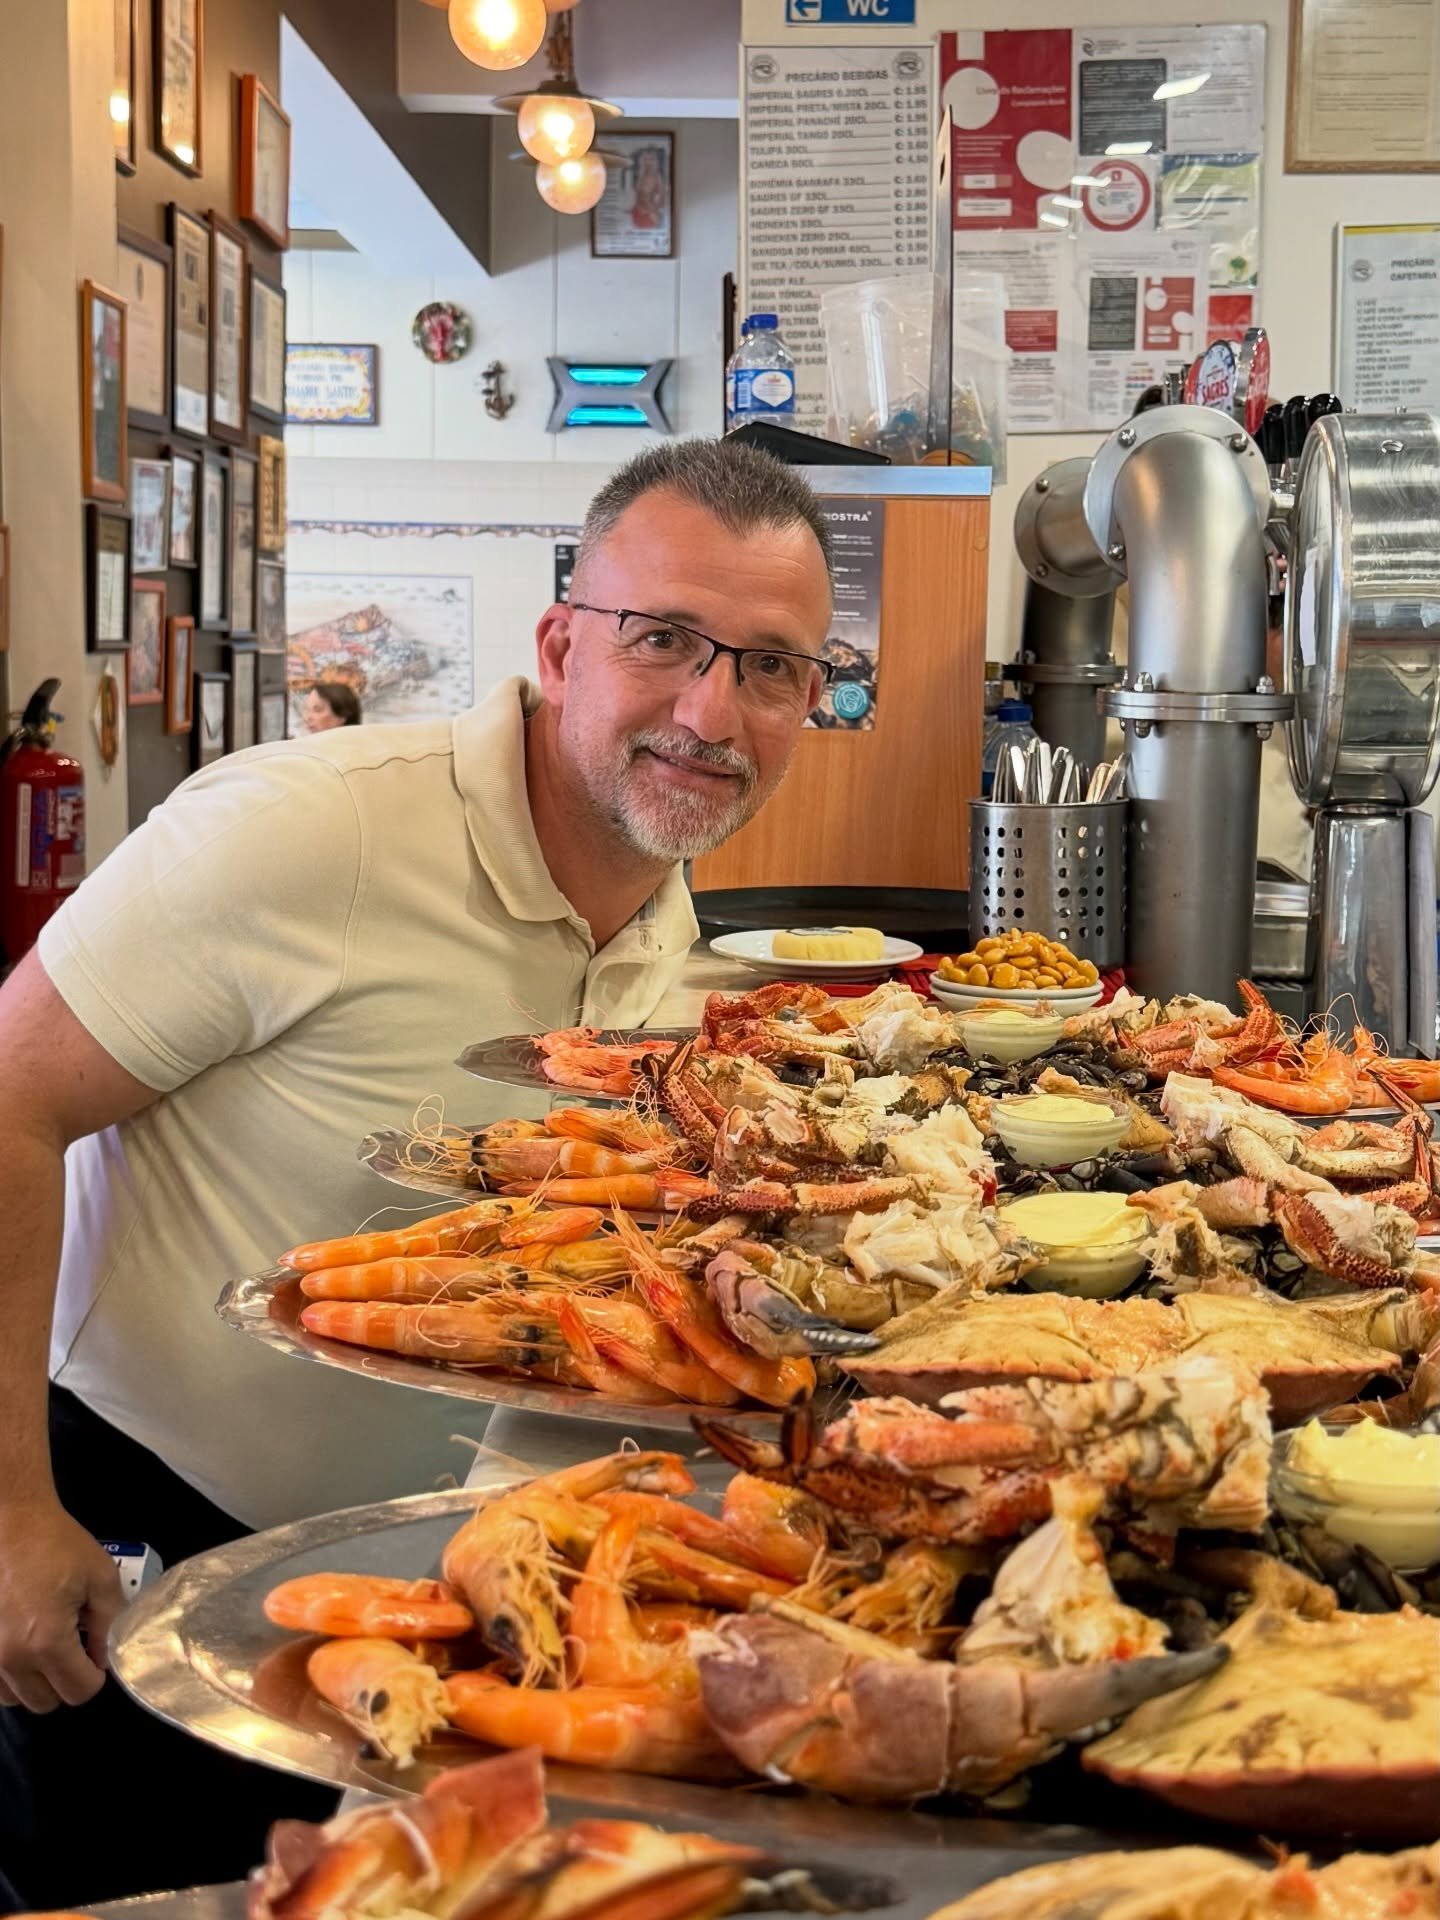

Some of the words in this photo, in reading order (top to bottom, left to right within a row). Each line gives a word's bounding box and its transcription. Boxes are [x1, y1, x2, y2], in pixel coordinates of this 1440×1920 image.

[847, 0, 890, 16] WC
[842, 70, 889, 81] BEBIDAS
[749, 91, 794, 100] IMPERIAL
[797, 88, 835, 98] SAGRES
[750, 104, 794, 114] IMPERIAL
[750, 118, 794, 128] IMPERIAL
[751, 132, 794, 142] IMPERIAL
[798, 131, 829, 140] TANGO
[751, 160, 789, 170] CANECA
[750, 193, 787, 202] SAGRES
[751, 206, 787, 215] SAGRES
[791, 206, 815, 215] ZERO
[751, 220, 797, 229] HEINEKEN
[751, 233, 797, 242] HEINEKEN
[800, 232, 825, 242] ZERO
[769, 261, 787, 270] TEA
[1201, 376, 1230, 402] SAGRES
